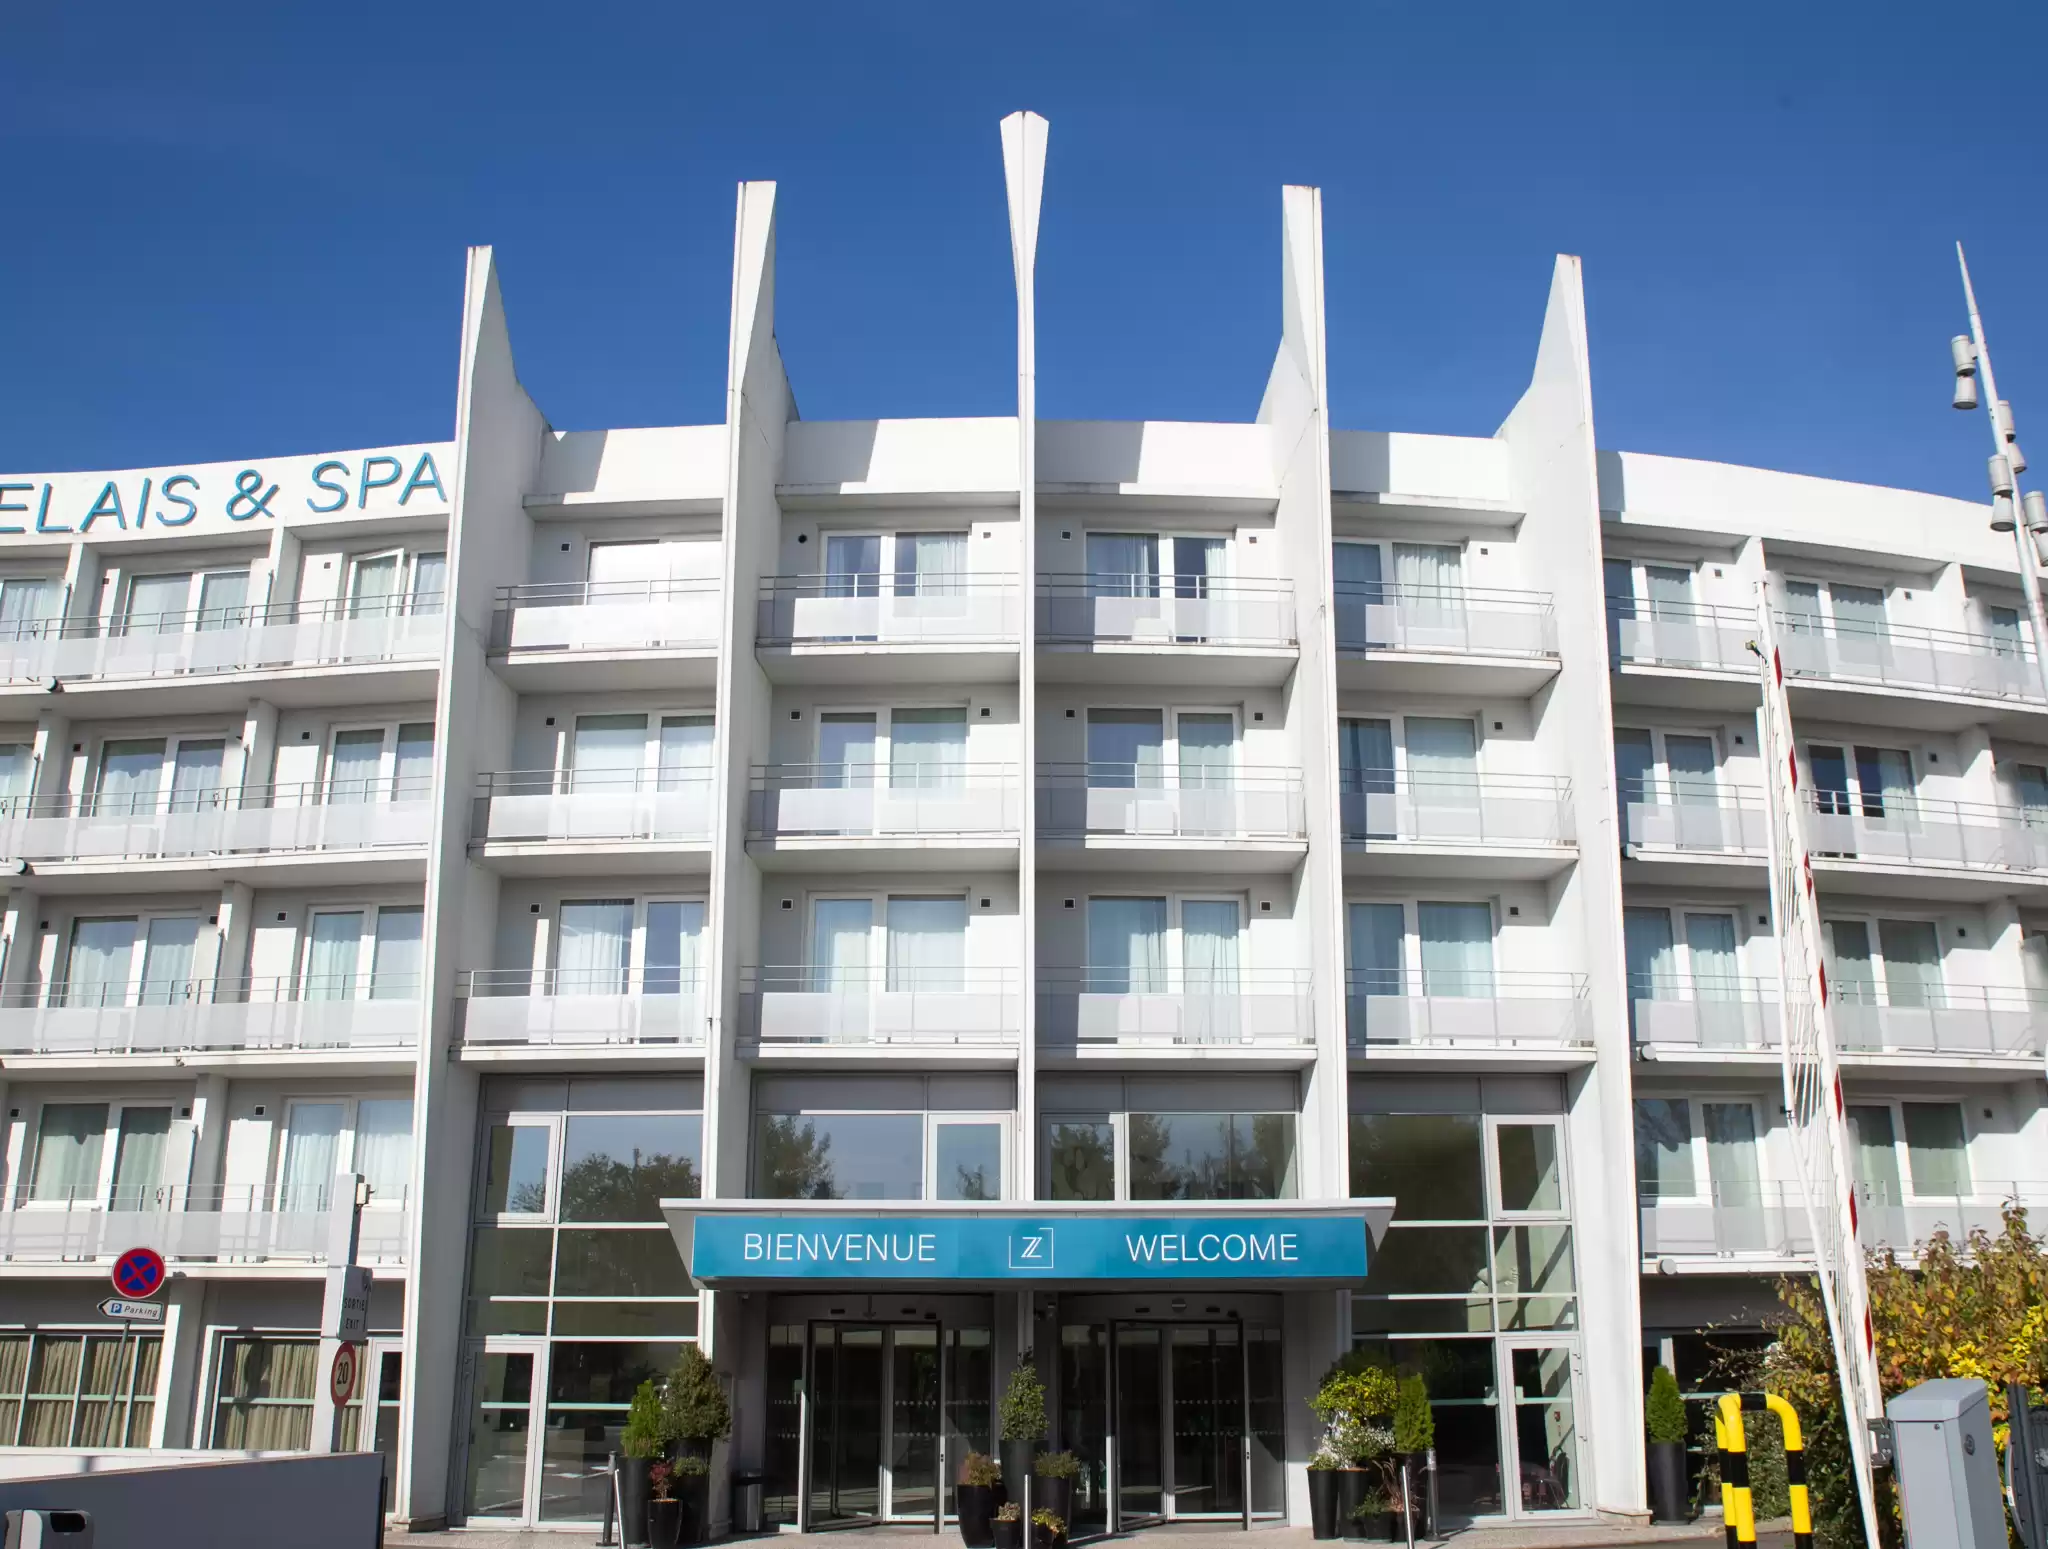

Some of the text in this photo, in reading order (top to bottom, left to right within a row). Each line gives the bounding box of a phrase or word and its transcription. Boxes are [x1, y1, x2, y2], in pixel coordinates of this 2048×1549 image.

[226, 469, 280, 521] &
[306, 452, 448, 512] SPA
[744, 1233, 936, 1261] BIENVENUE
[1125, 1233, 1299, 1261] WELCOME
[124, 1305, 158, 1317] Parking
[344, 1298, 365, 1311] SORTIE
[345, 1318, 359, 1329] EXIT
[336, 1361, 349, 1384] 20
